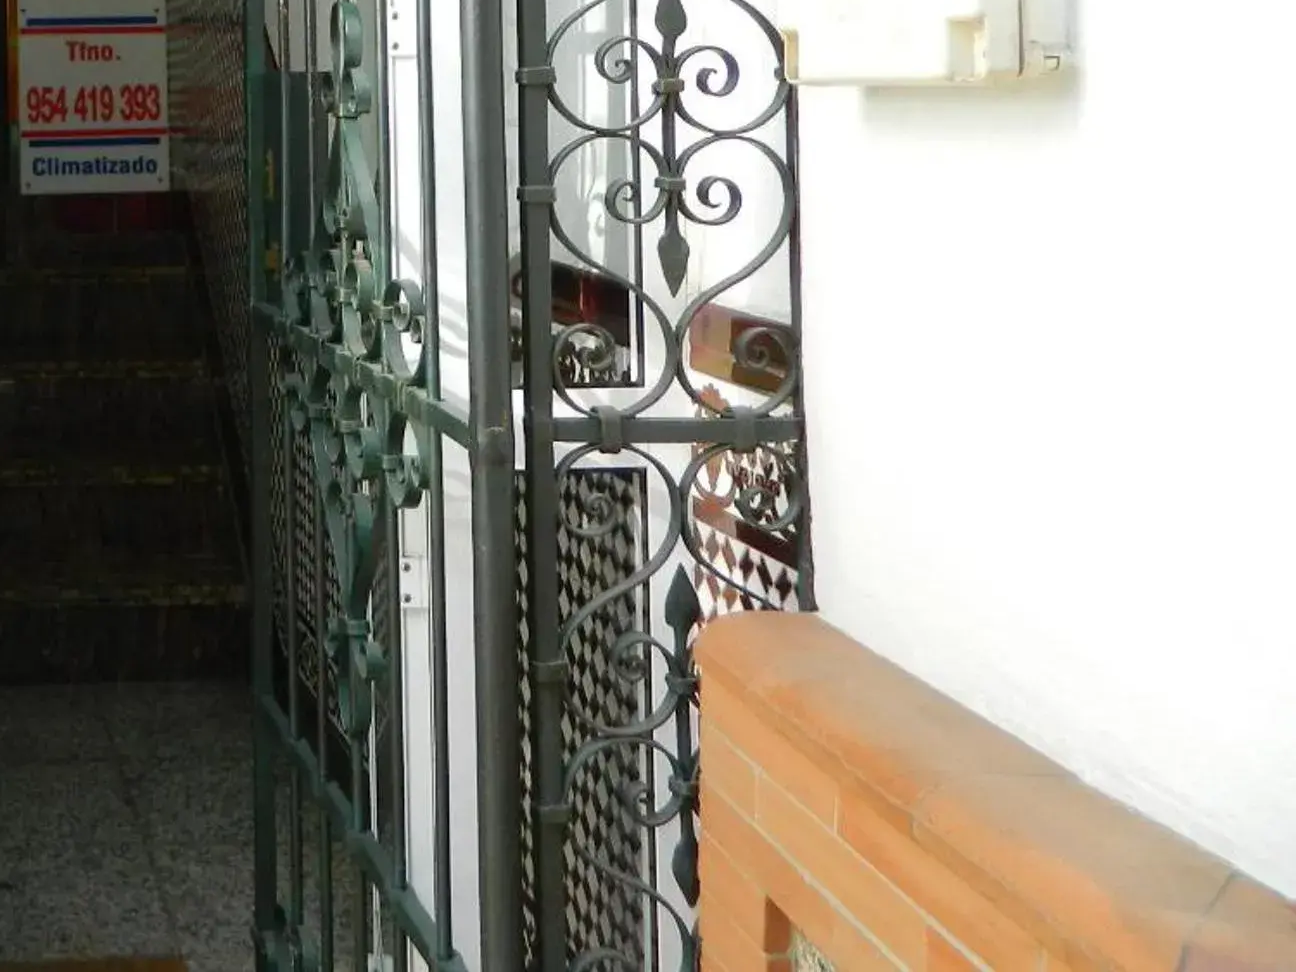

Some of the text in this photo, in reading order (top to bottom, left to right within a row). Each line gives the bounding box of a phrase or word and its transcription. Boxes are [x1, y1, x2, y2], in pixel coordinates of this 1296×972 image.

[26, 84, 161, 123] 954 419 393
[32, 155, 157, 177] Climatizado
